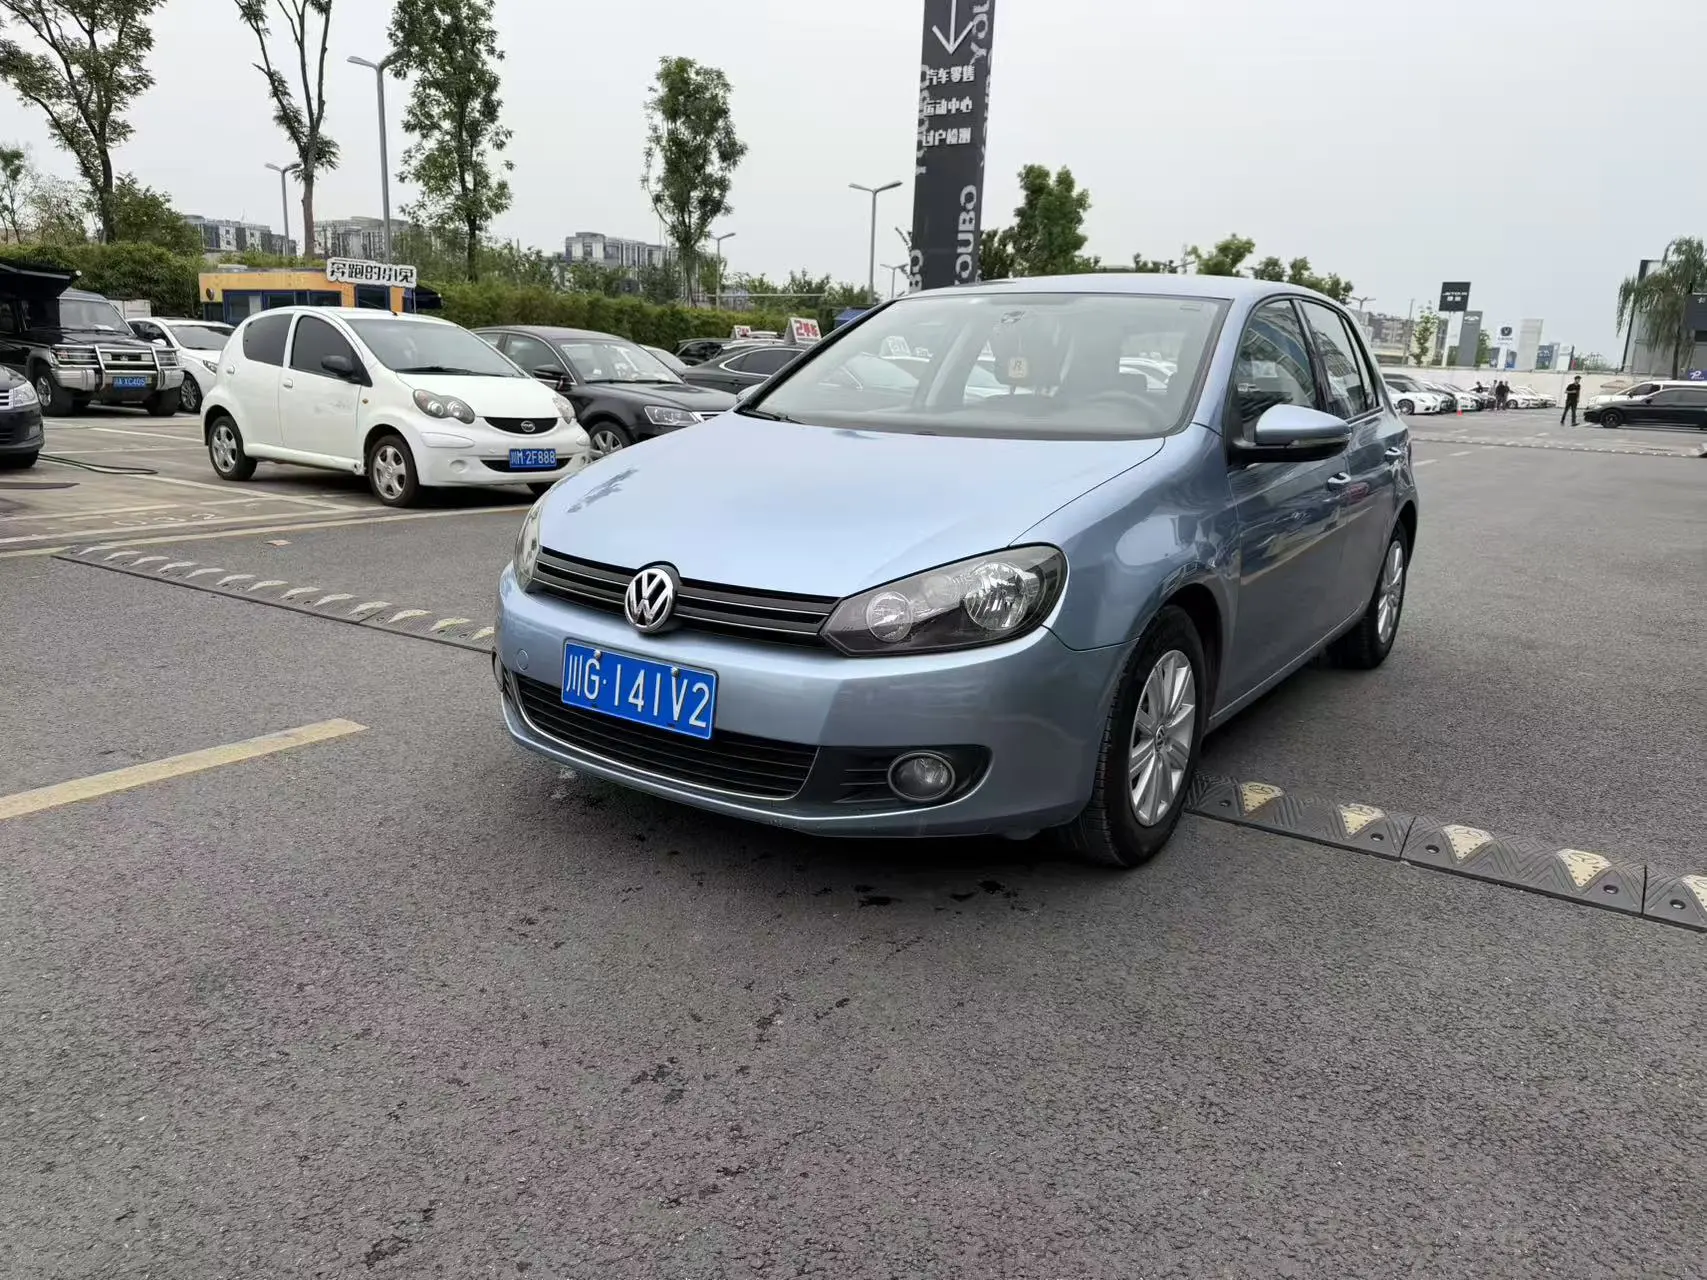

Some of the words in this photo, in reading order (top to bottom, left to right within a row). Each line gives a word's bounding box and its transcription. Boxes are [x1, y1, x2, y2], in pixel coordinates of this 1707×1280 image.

[928, 65, 975, 85] 汽车零售
[923, 96, 973, 116] 运动中心
